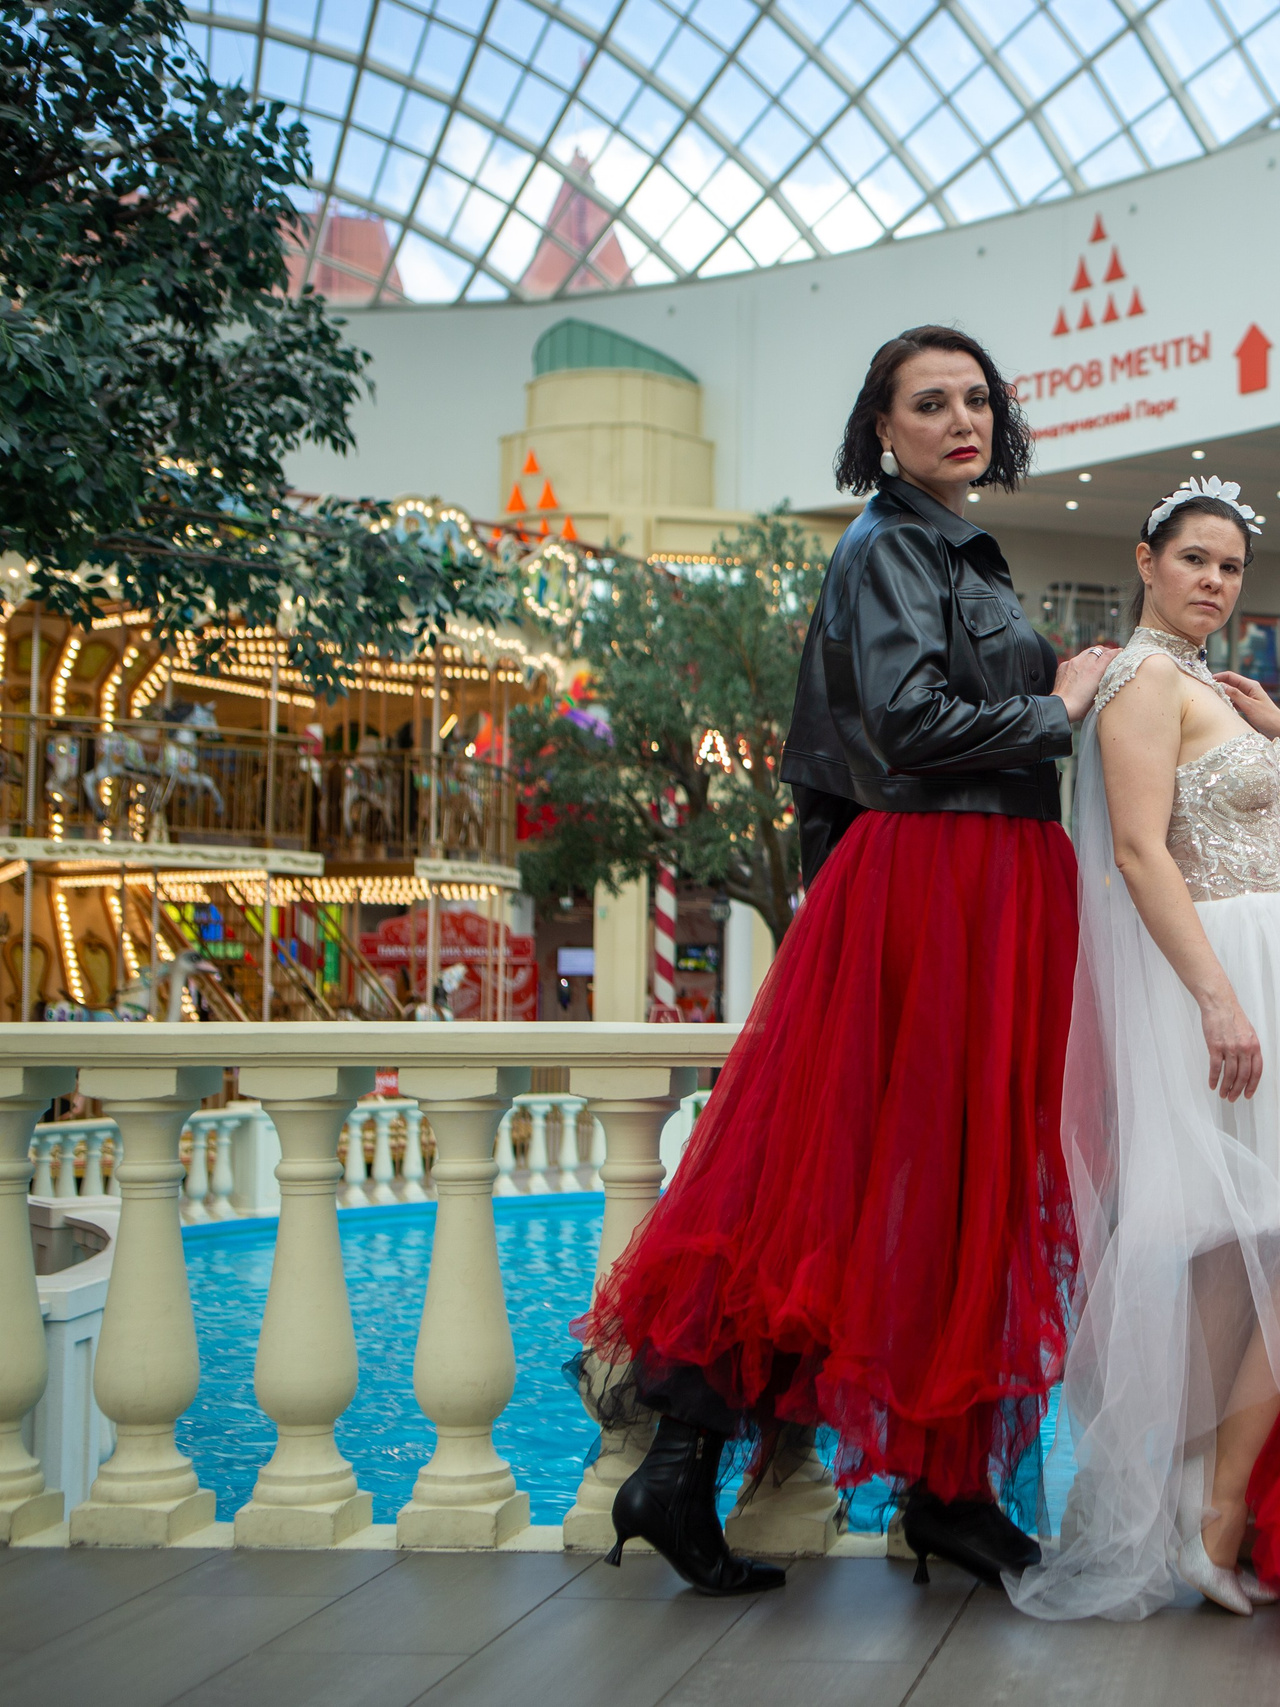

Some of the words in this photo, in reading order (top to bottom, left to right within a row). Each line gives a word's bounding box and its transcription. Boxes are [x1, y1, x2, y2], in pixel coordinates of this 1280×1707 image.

[1004, 359, 1105, 404] СТРОВ
[1109, 331, 1211, 382] МЕЧТЫ
[1135, 397, 1178, 419] Парк
